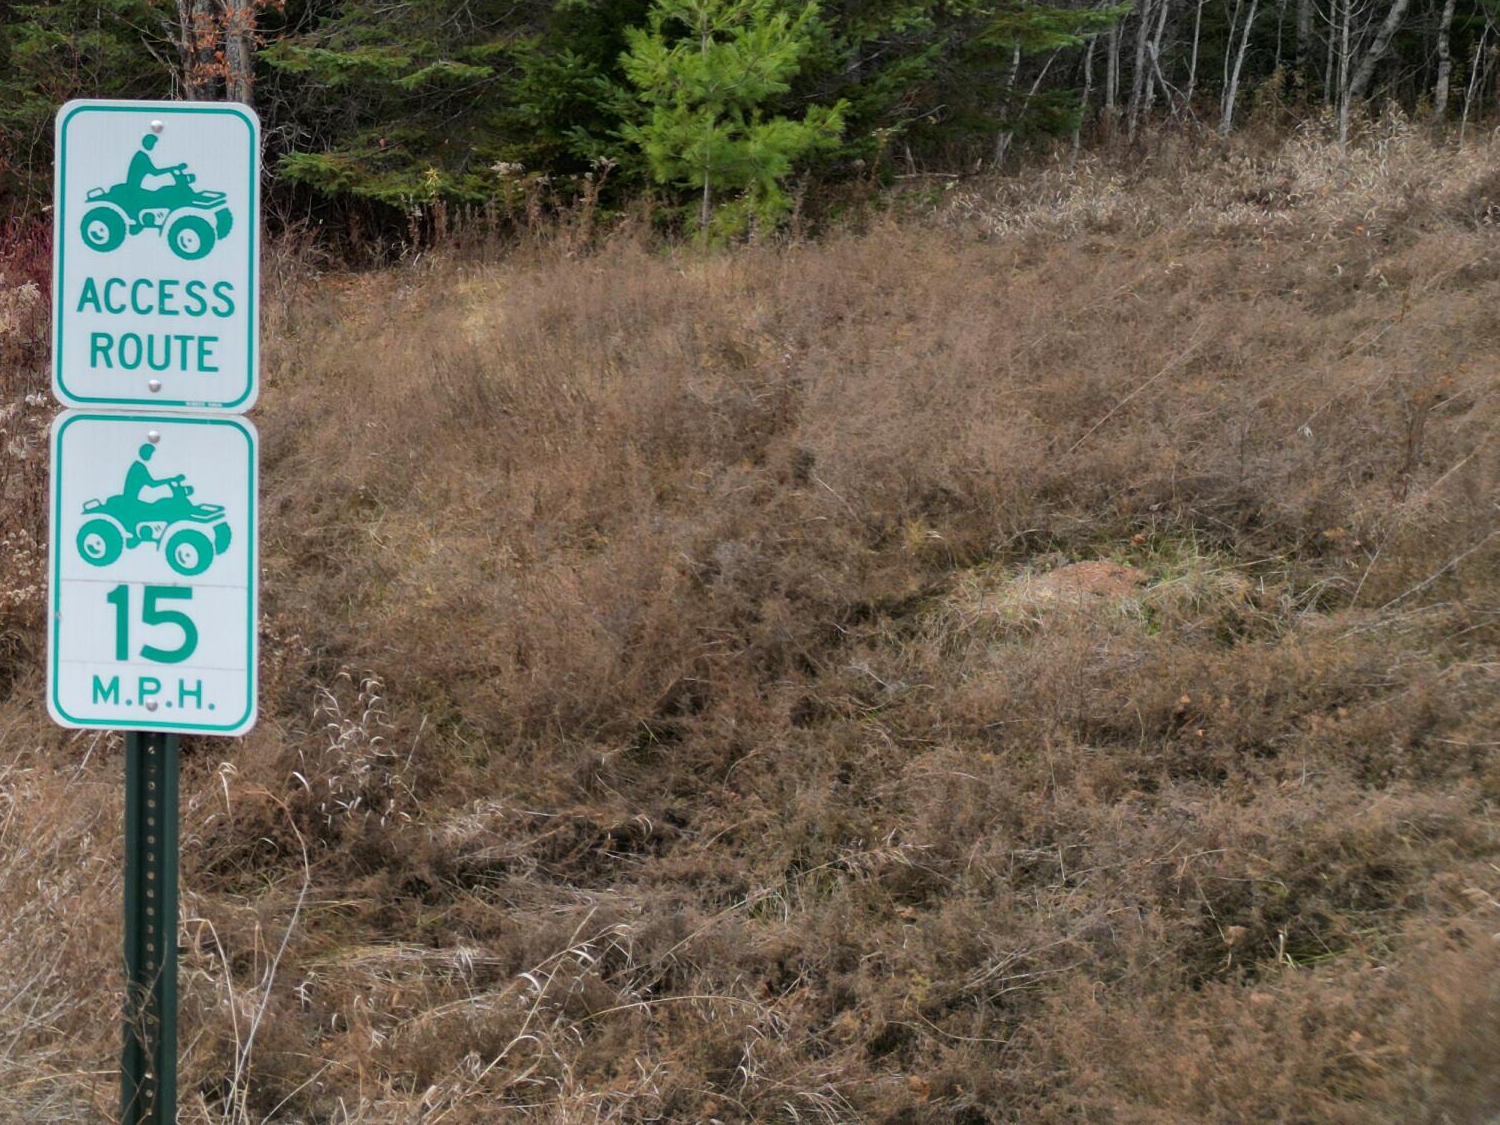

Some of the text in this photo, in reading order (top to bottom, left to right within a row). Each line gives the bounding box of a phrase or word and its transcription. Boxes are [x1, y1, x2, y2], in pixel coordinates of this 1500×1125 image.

[76, 277, 236, 318] ACCESS
[89, 331, 220, 373] ROUTE
[106, 583, 200, 665] 15
[92, 674, 216, 711] M.P.H.
